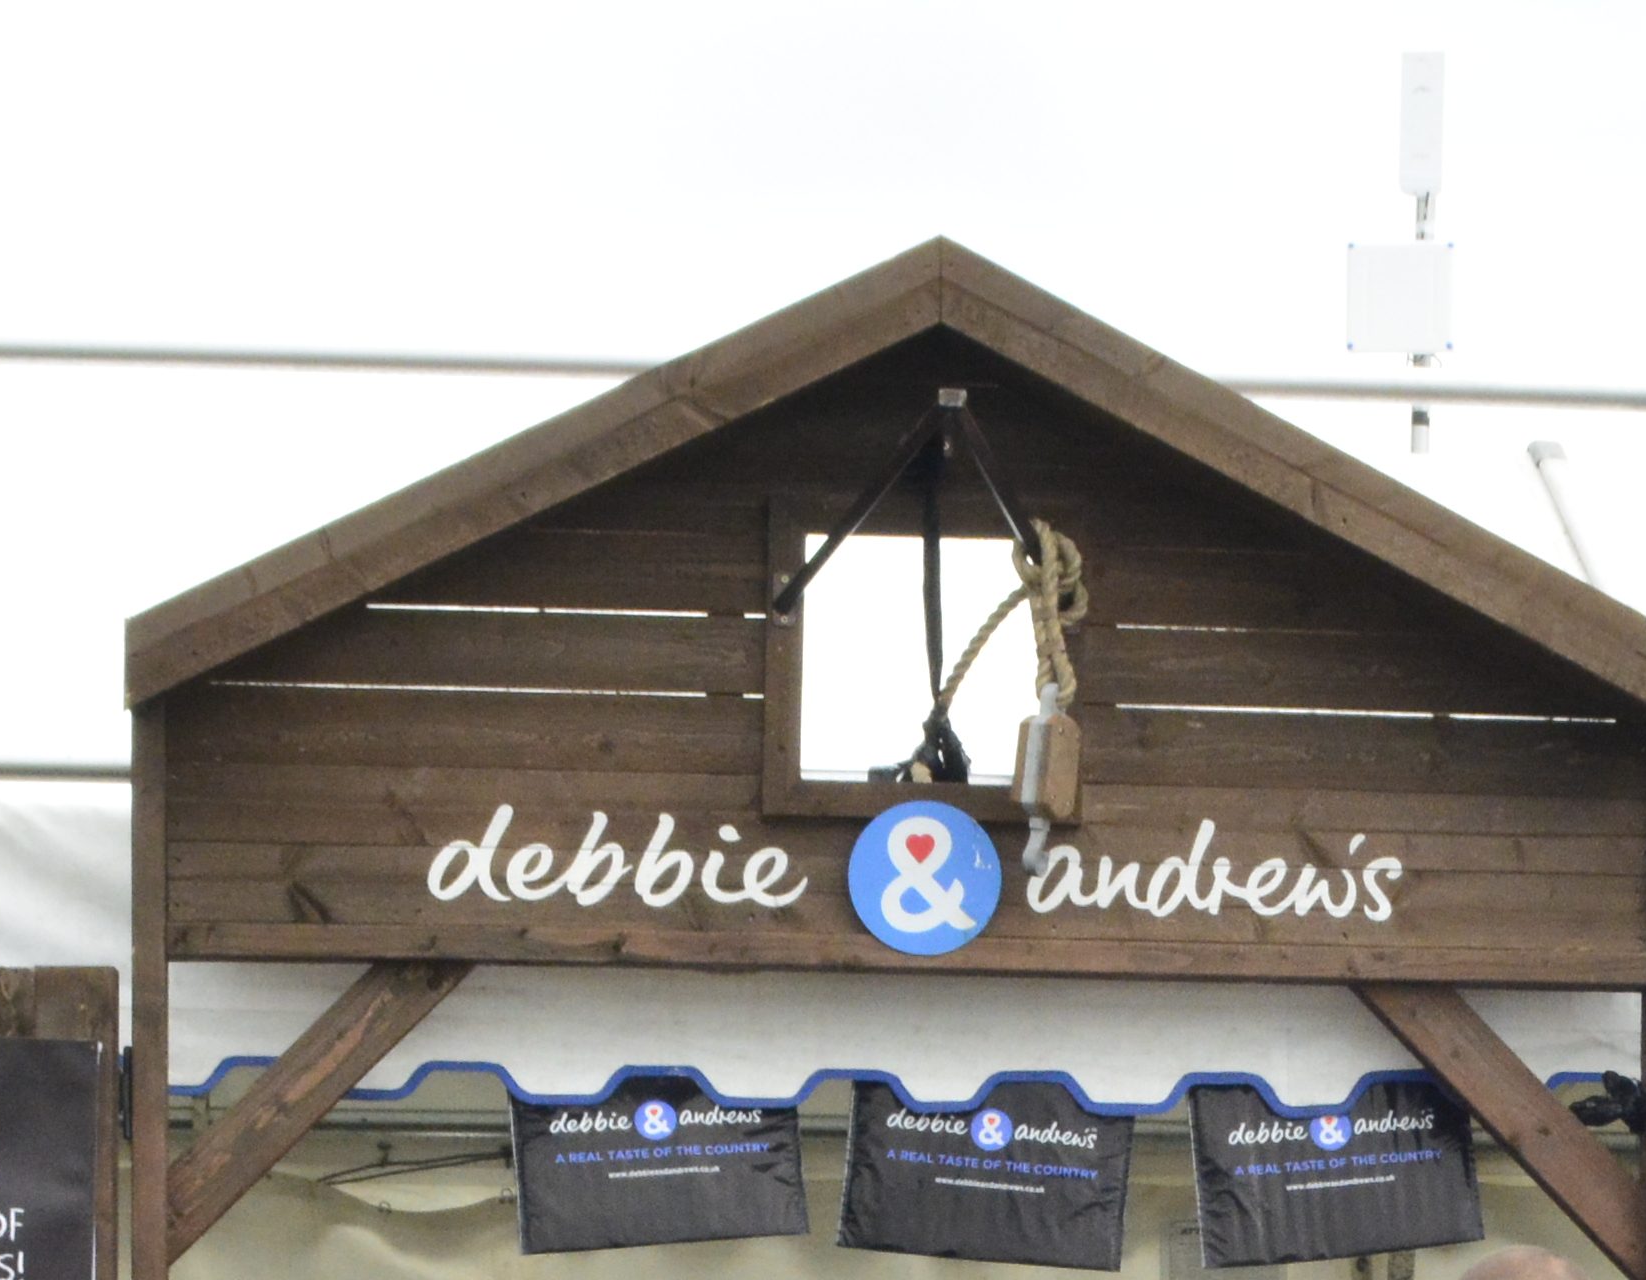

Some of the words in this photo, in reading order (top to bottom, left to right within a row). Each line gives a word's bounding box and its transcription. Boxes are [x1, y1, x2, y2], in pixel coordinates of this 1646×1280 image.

[427, 803, 814, 908] debbie
[873, 810, 983, 942] &
[1023, 812, 1403, 922] andrew's
[549, 1112, 632, 1134] debbie
[643, 1104, 671, 1135] &
[886, 1108, 967, 1135] debbie
[979, 1112, 1004, 1145] &
[1228, 1122, 1308, 1146] debbie
[1320, 1116, 1346, 1144] &
[555, 1153, 565, 1164] A
[569, 1151, 603, 1163] REAL
[608, 1148, 650, 1161] TASTE
[653, 1147, 672, 1158] OF
[676, 1145, 702, 1157] THE
[705, 1143, 770, 1155] COUNTRY
[887, 1150, 897, 1160] A
[900, 1151, 933, 1164] REAL
[938, 1155, 978, 1169] TASTE
[983, 1160, 1002, 1170] OF
[1006, 1161, 1030, 1173] THE
[1034, 1164, 1098, 1180] COUNTRY
